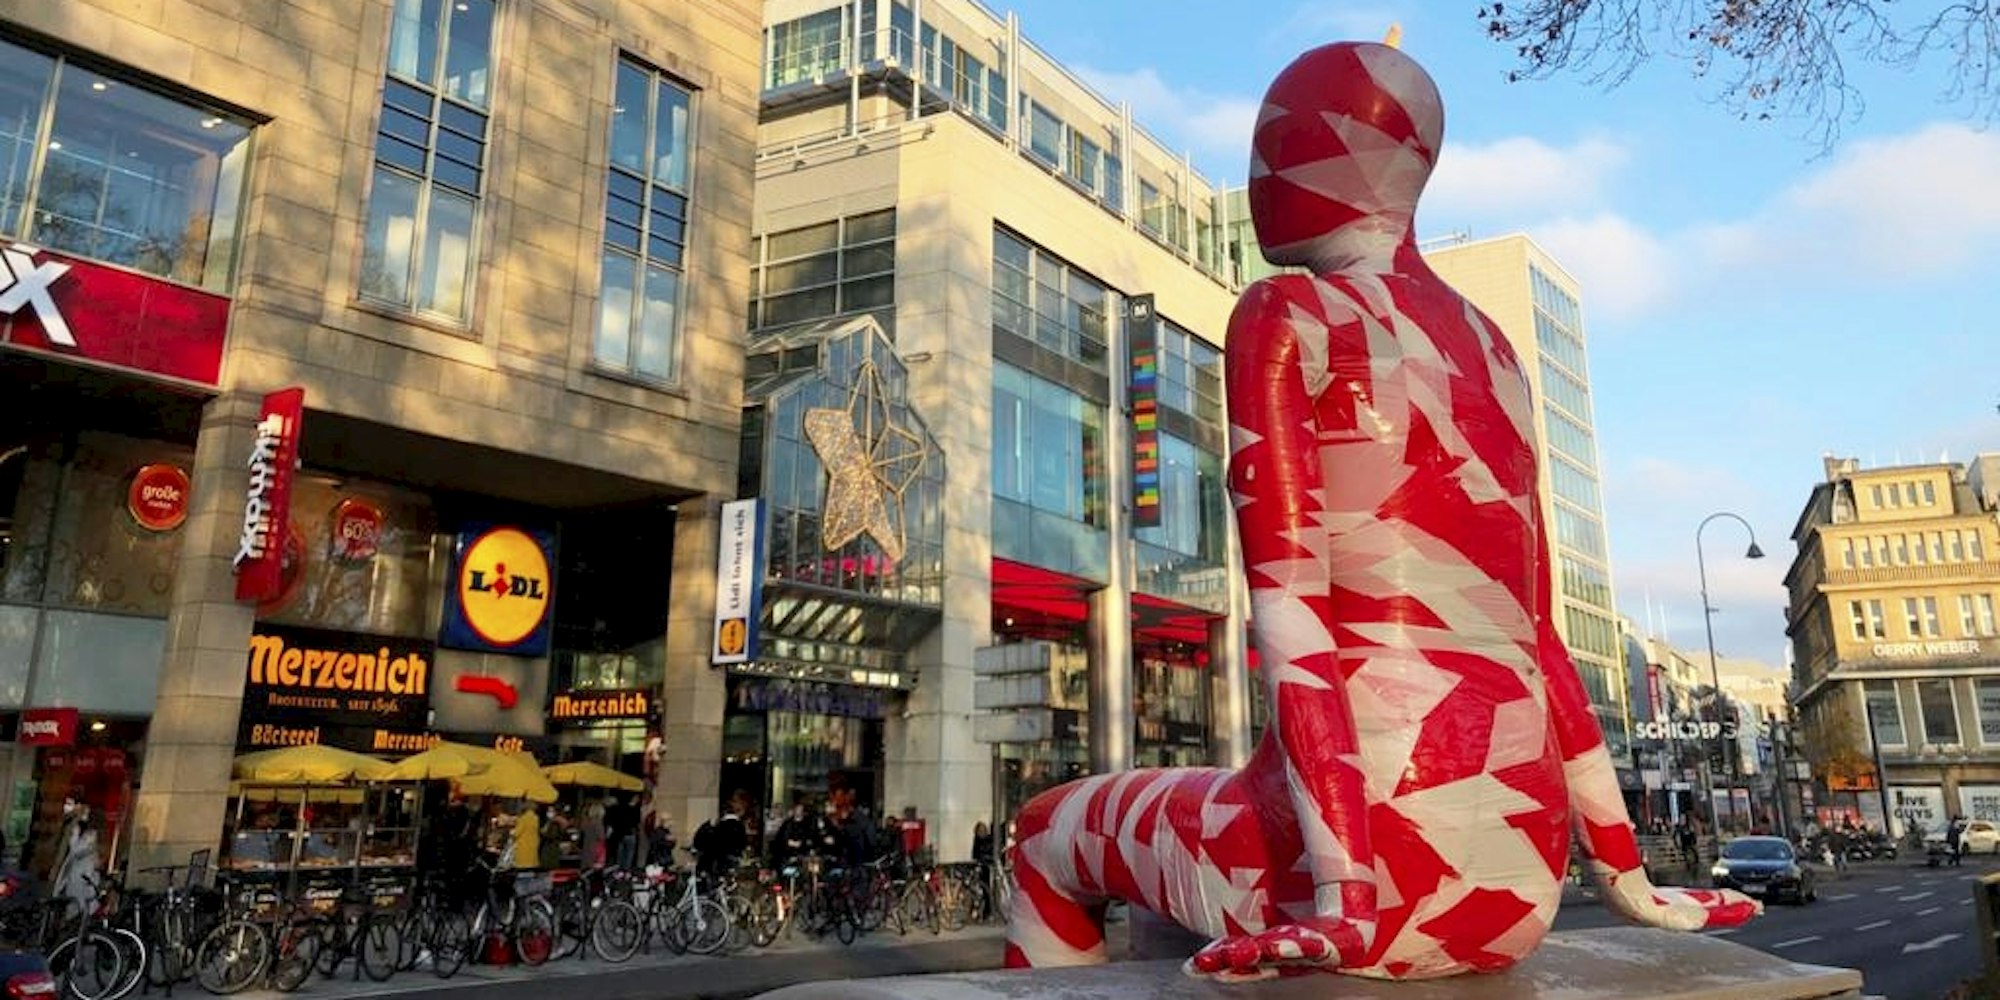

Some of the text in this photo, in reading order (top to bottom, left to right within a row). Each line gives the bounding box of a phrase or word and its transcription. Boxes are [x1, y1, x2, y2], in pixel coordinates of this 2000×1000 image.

[1873, 640, 1981, 658] GERRY WEBER
[250, 634, 428, 695] Merzenich
[553, 692, 647, 717] Merzenich
[251, 723, 320, 746] Bäckerei
[1894, 808, 1933, 820] GUYS
